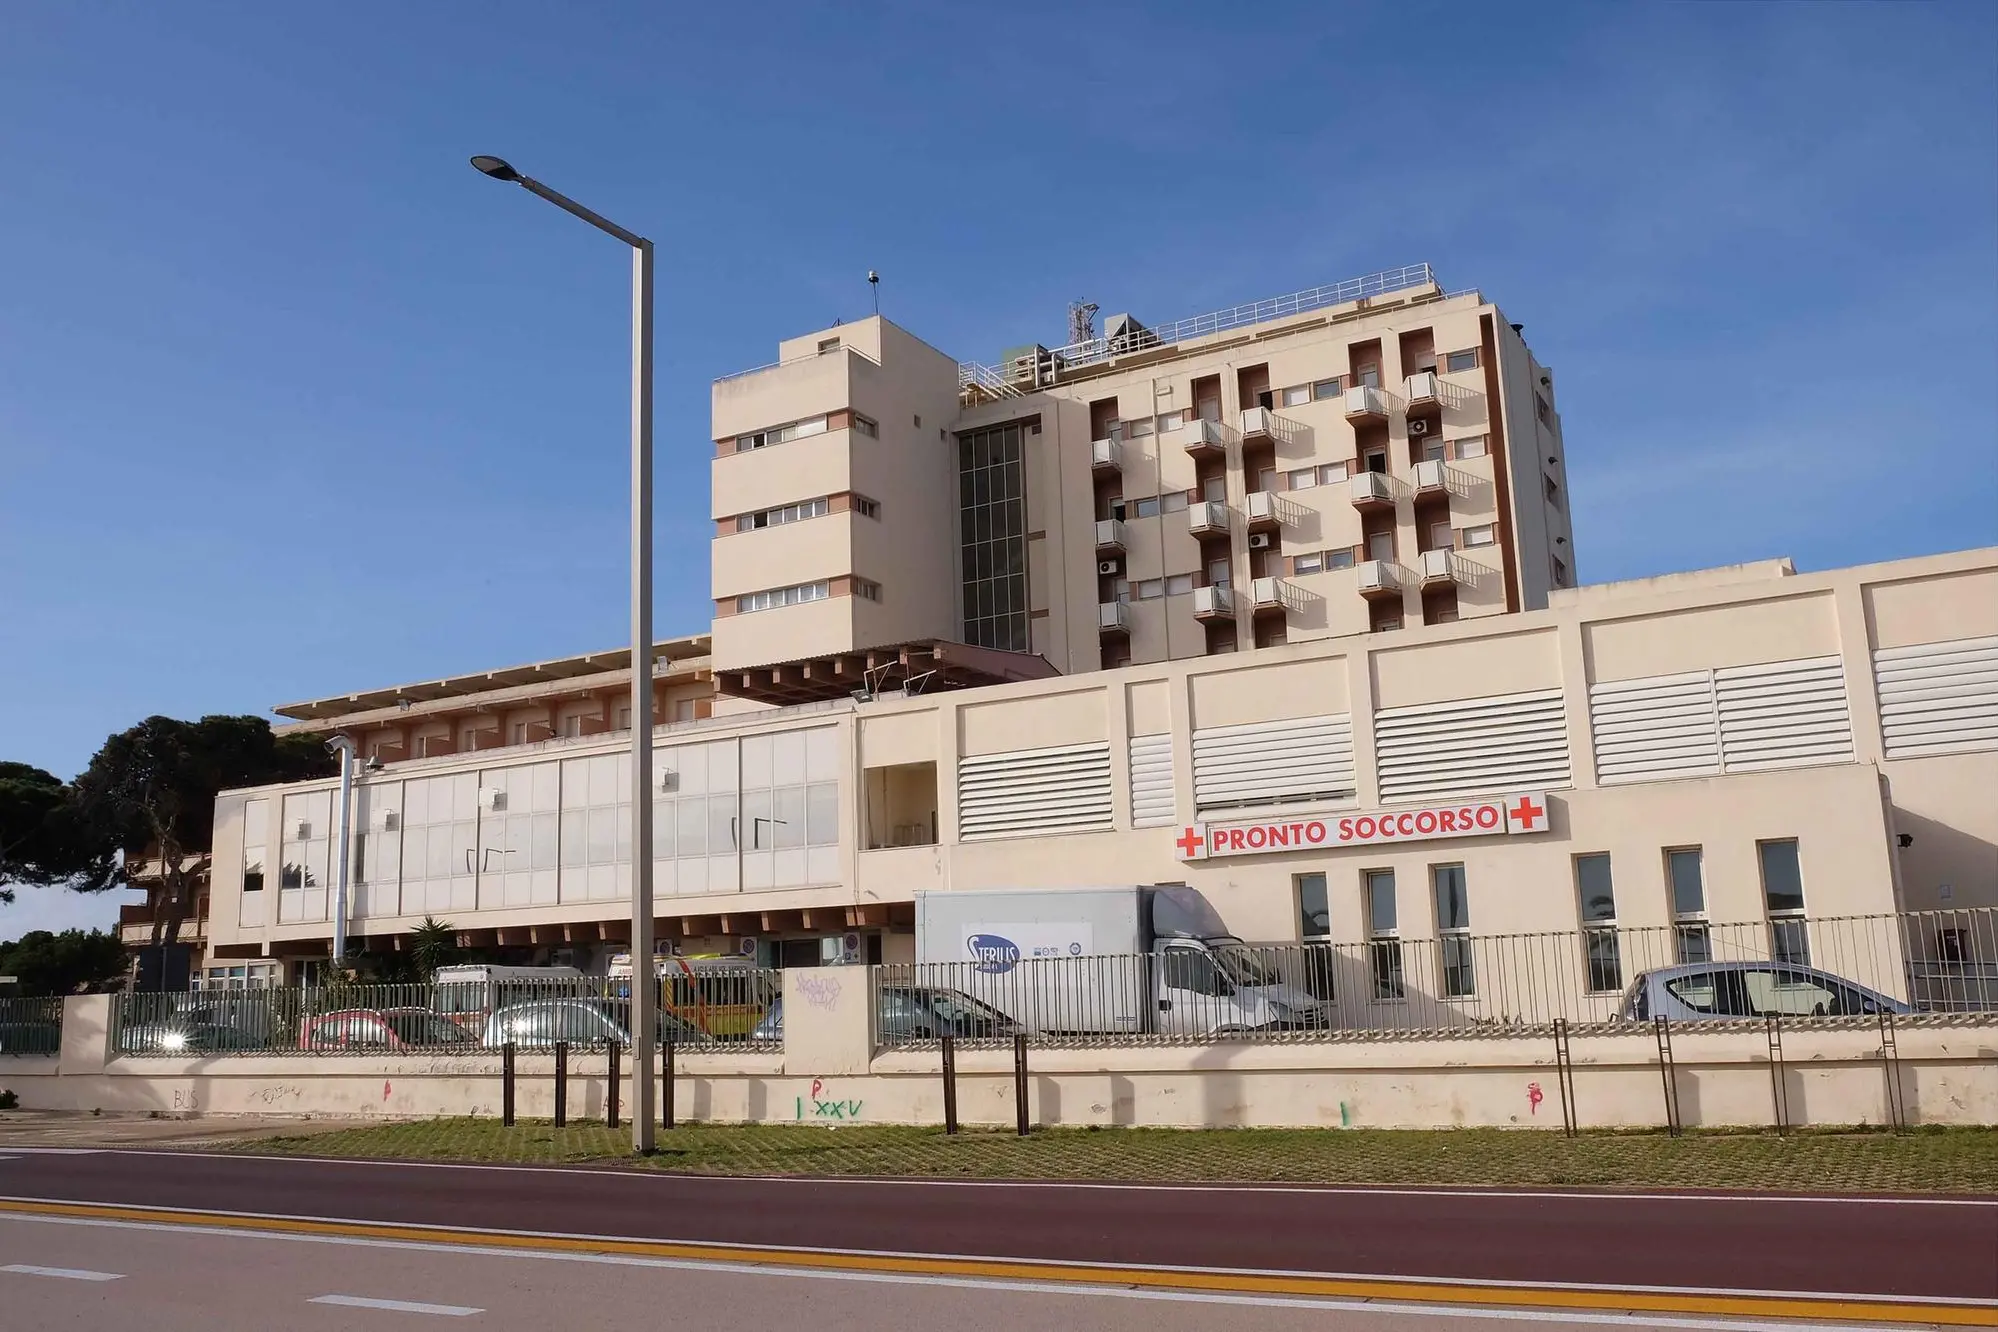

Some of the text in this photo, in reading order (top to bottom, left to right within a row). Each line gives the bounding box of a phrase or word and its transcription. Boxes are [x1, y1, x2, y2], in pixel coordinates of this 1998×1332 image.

[1214, 805, 1499, 852] PRONTO SOCCORSO
[968, 935, 1017, 963] STERILIS
